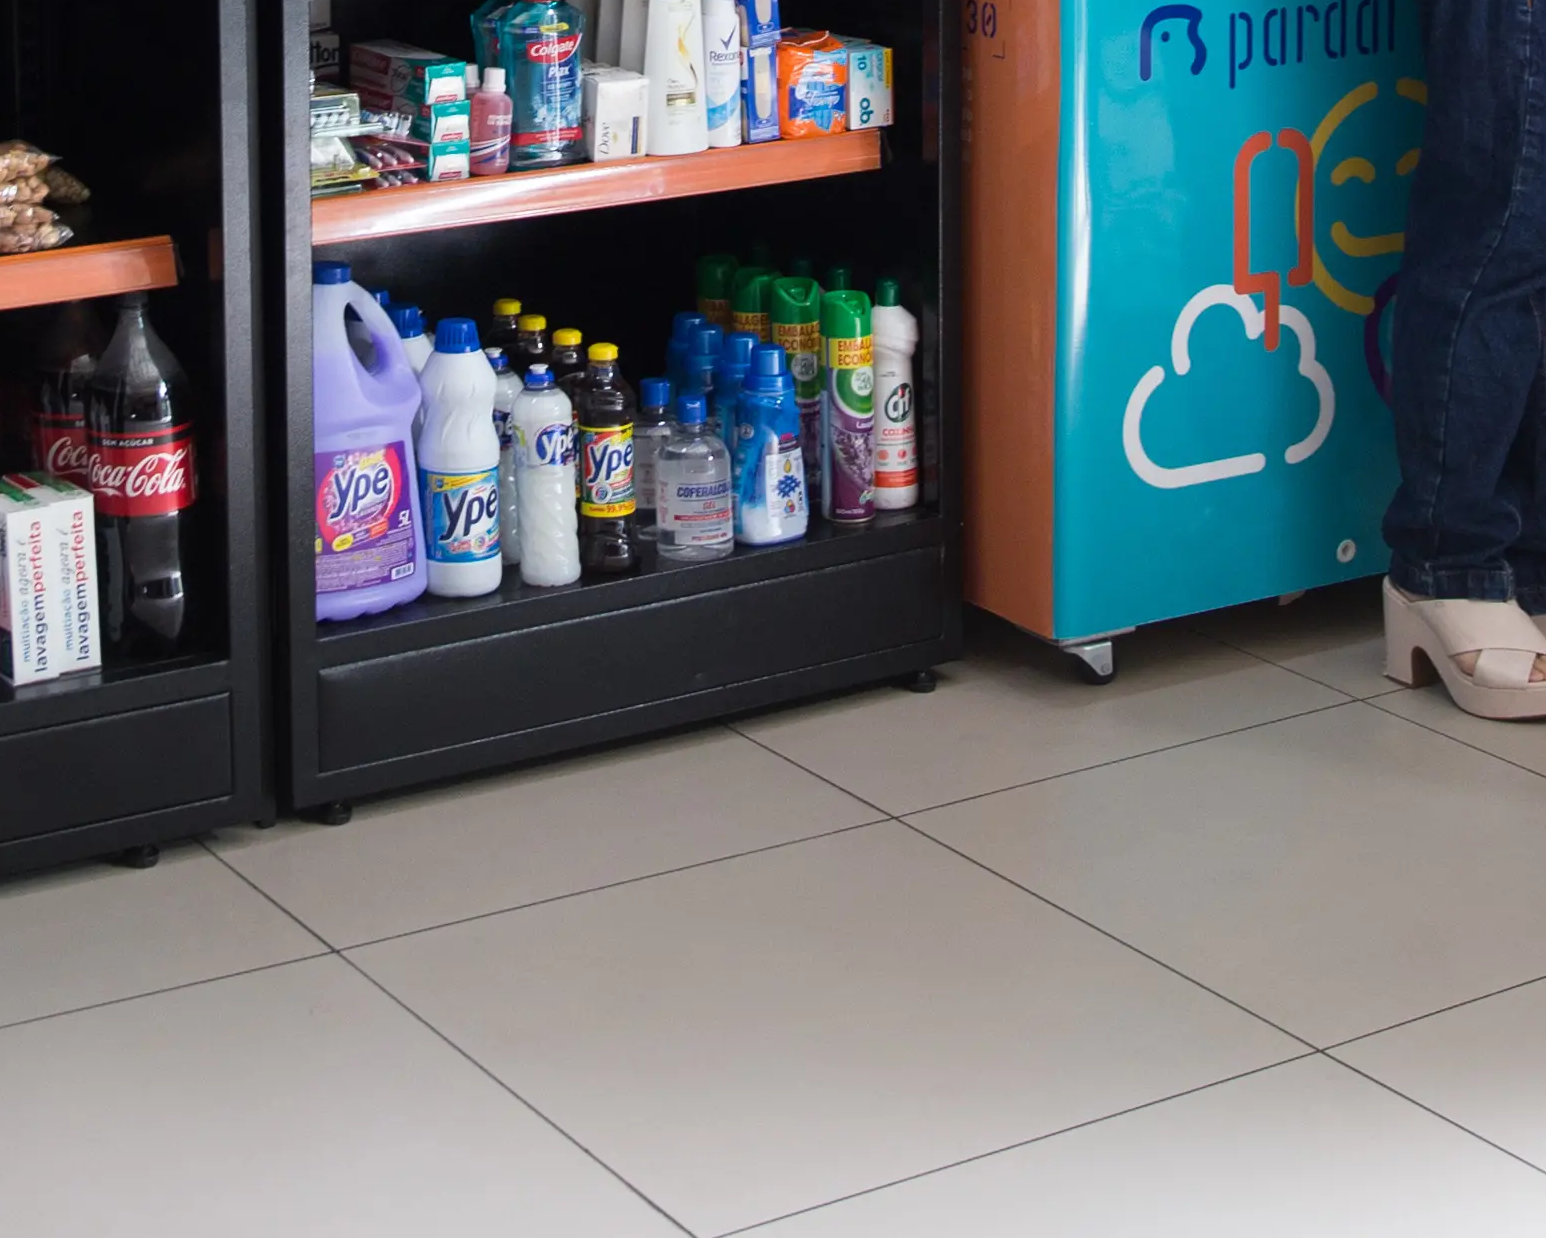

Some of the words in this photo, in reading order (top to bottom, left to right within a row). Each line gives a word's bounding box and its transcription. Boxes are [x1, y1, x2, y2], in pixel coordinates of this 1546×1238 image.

[529, 38, 575, 58] Colgate
[709, 50, 740, 63] Rexon
[857, 53, 867, 72] 10
[599, 122, 611, 156] Dove
[886, 384, 913, 422] Cif
[118, 437, 155, 448] AÇÚCAR
[89, 448, 188, 498] Coca-Cola
[328, 463, 391, 520] Ypê
[437, 484, 499, 543] Ypê
